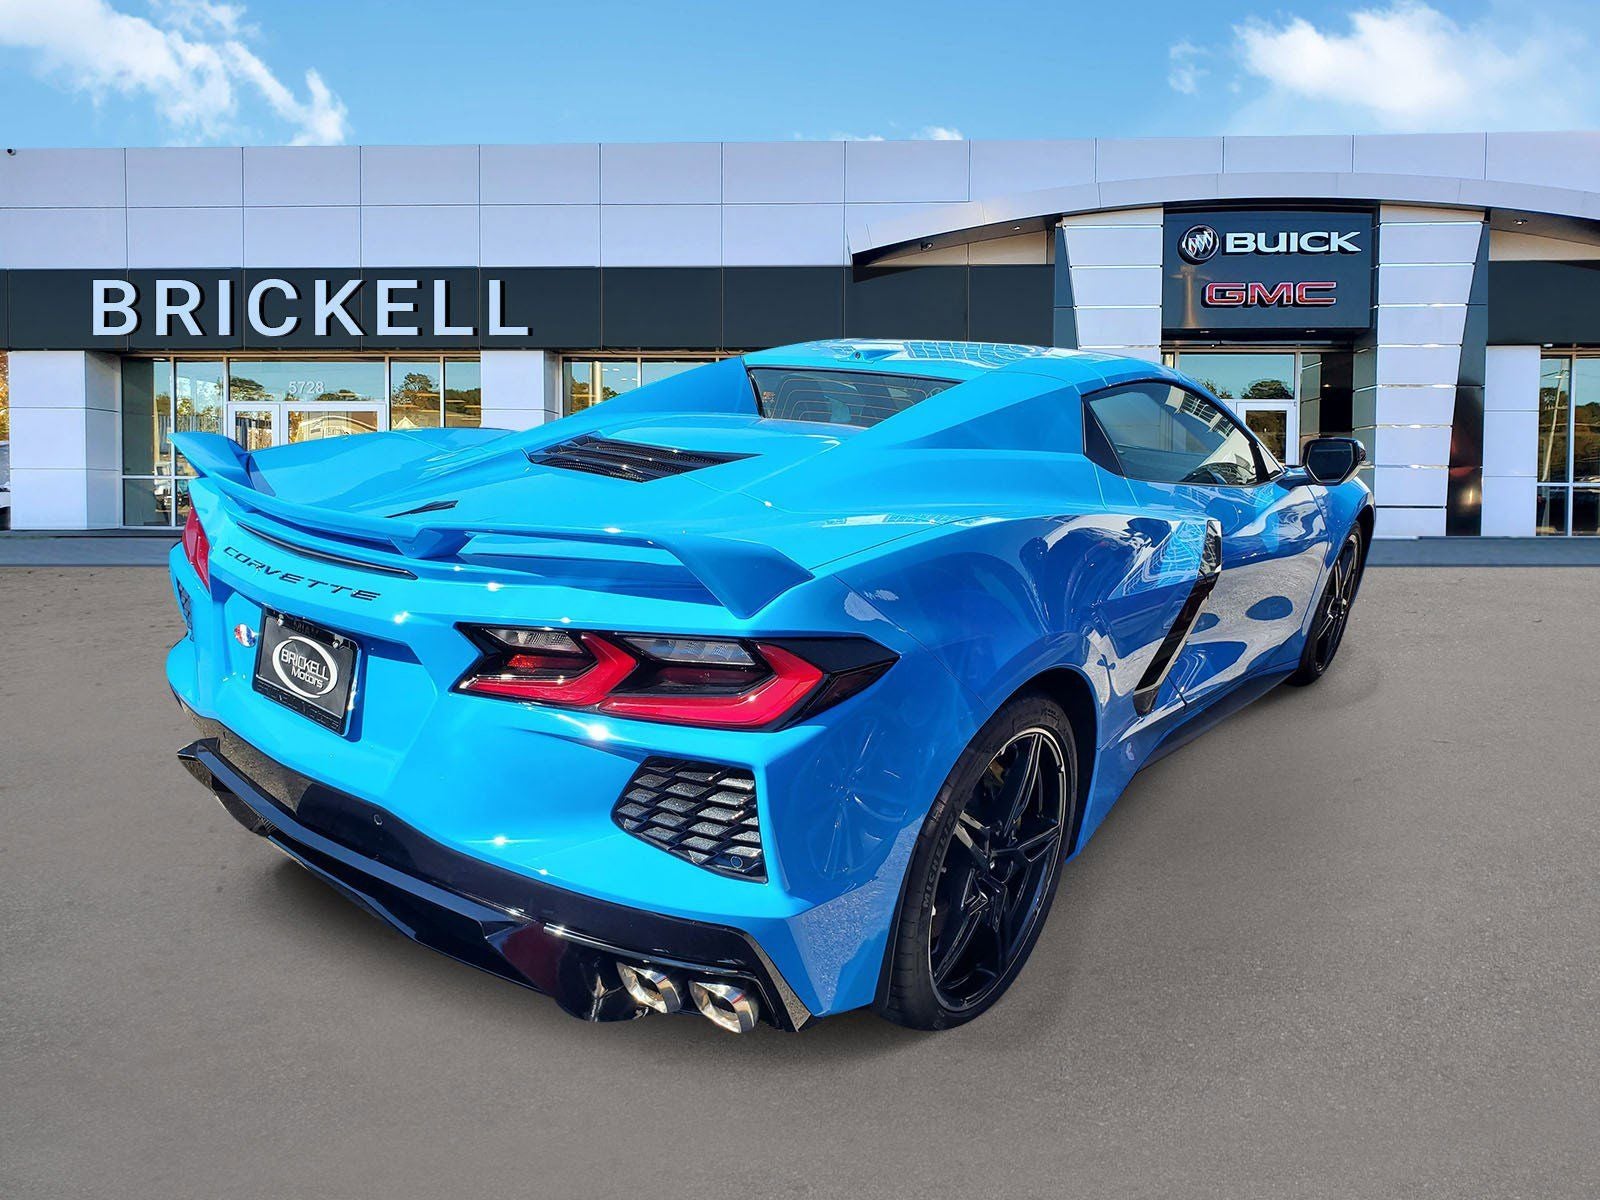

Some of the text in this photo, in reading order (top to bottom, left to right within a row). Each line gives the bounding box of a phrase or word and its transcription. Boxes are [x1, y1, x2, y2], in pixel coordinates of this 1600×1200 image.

[1225, 231, 1362, 253] BUICK
[1205, 281, 1337, 306] GMC
[92, 279, 530, 337] BRICKELL
[288, 381, 325, 394] 5728
[223, 546, 382, 601] CORVETTE
[281, 648, 329, 681] BRICKELL
[291, 665, 323, 688] Motors
